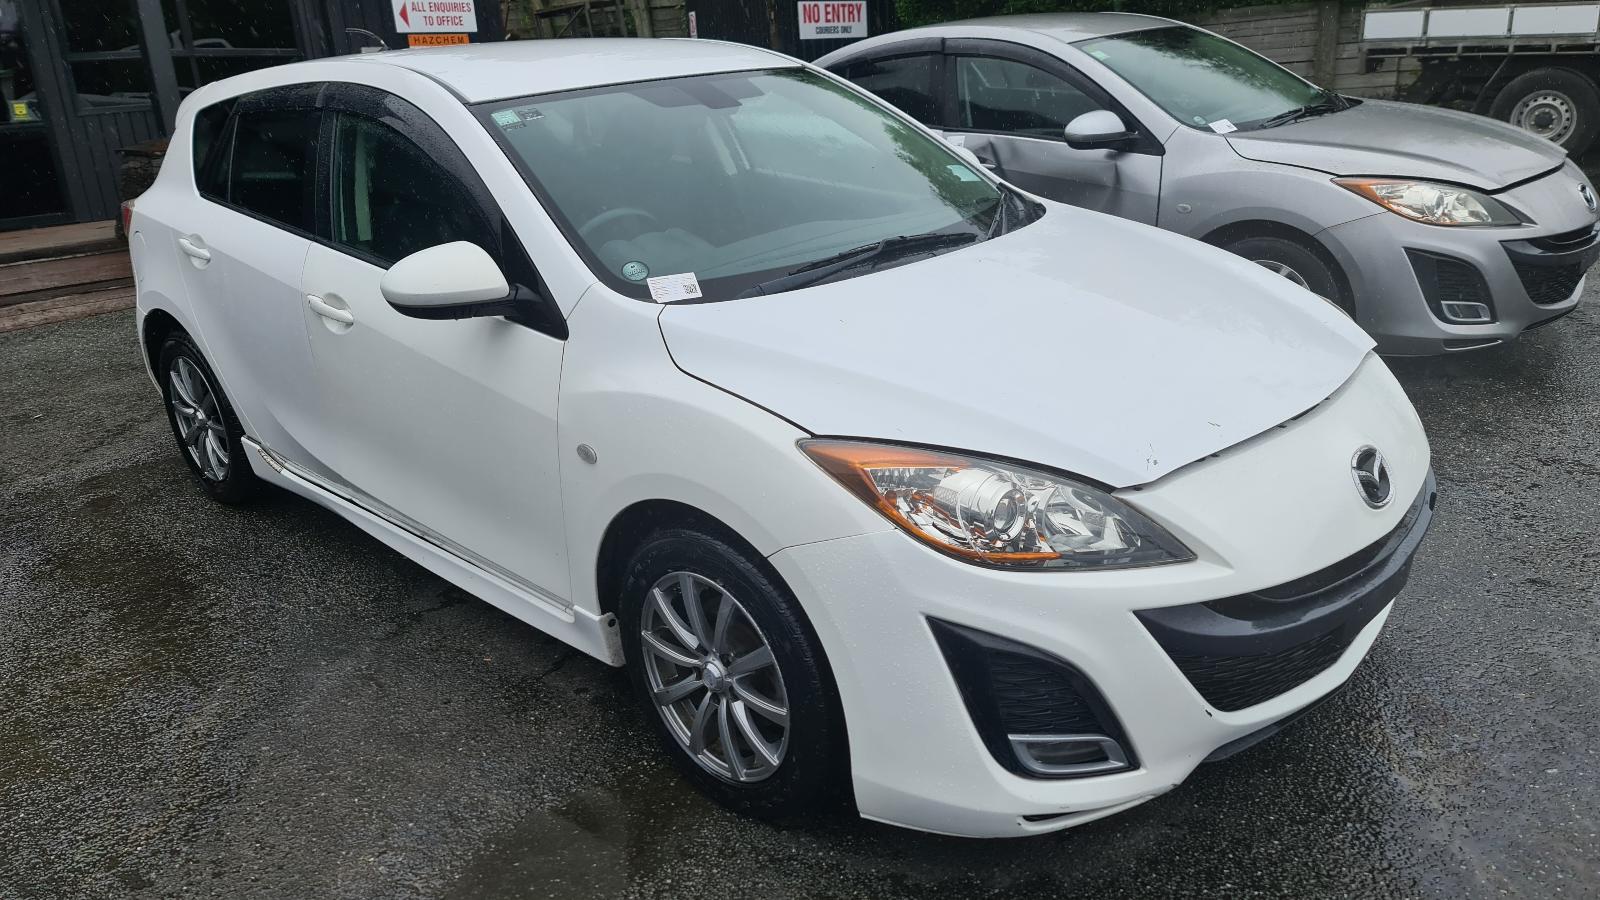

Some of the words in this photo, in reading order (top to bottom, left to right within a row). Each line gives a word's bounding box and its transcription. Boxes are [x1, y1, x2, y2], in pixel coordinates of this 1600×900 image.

[411, 2, 427, 12] ALL
[429, 2, 472, 13] ENQUIRIES
[803, 3, 820, 24] NO
[825, 3, 862, 23] ENTRY
[423, 16, 434, 26] TO
[436, 16, 464, 26] OFFICE
[815, 26, 839, 34] COURIERS
[414, 36, 465, 45] HAZCHEM
